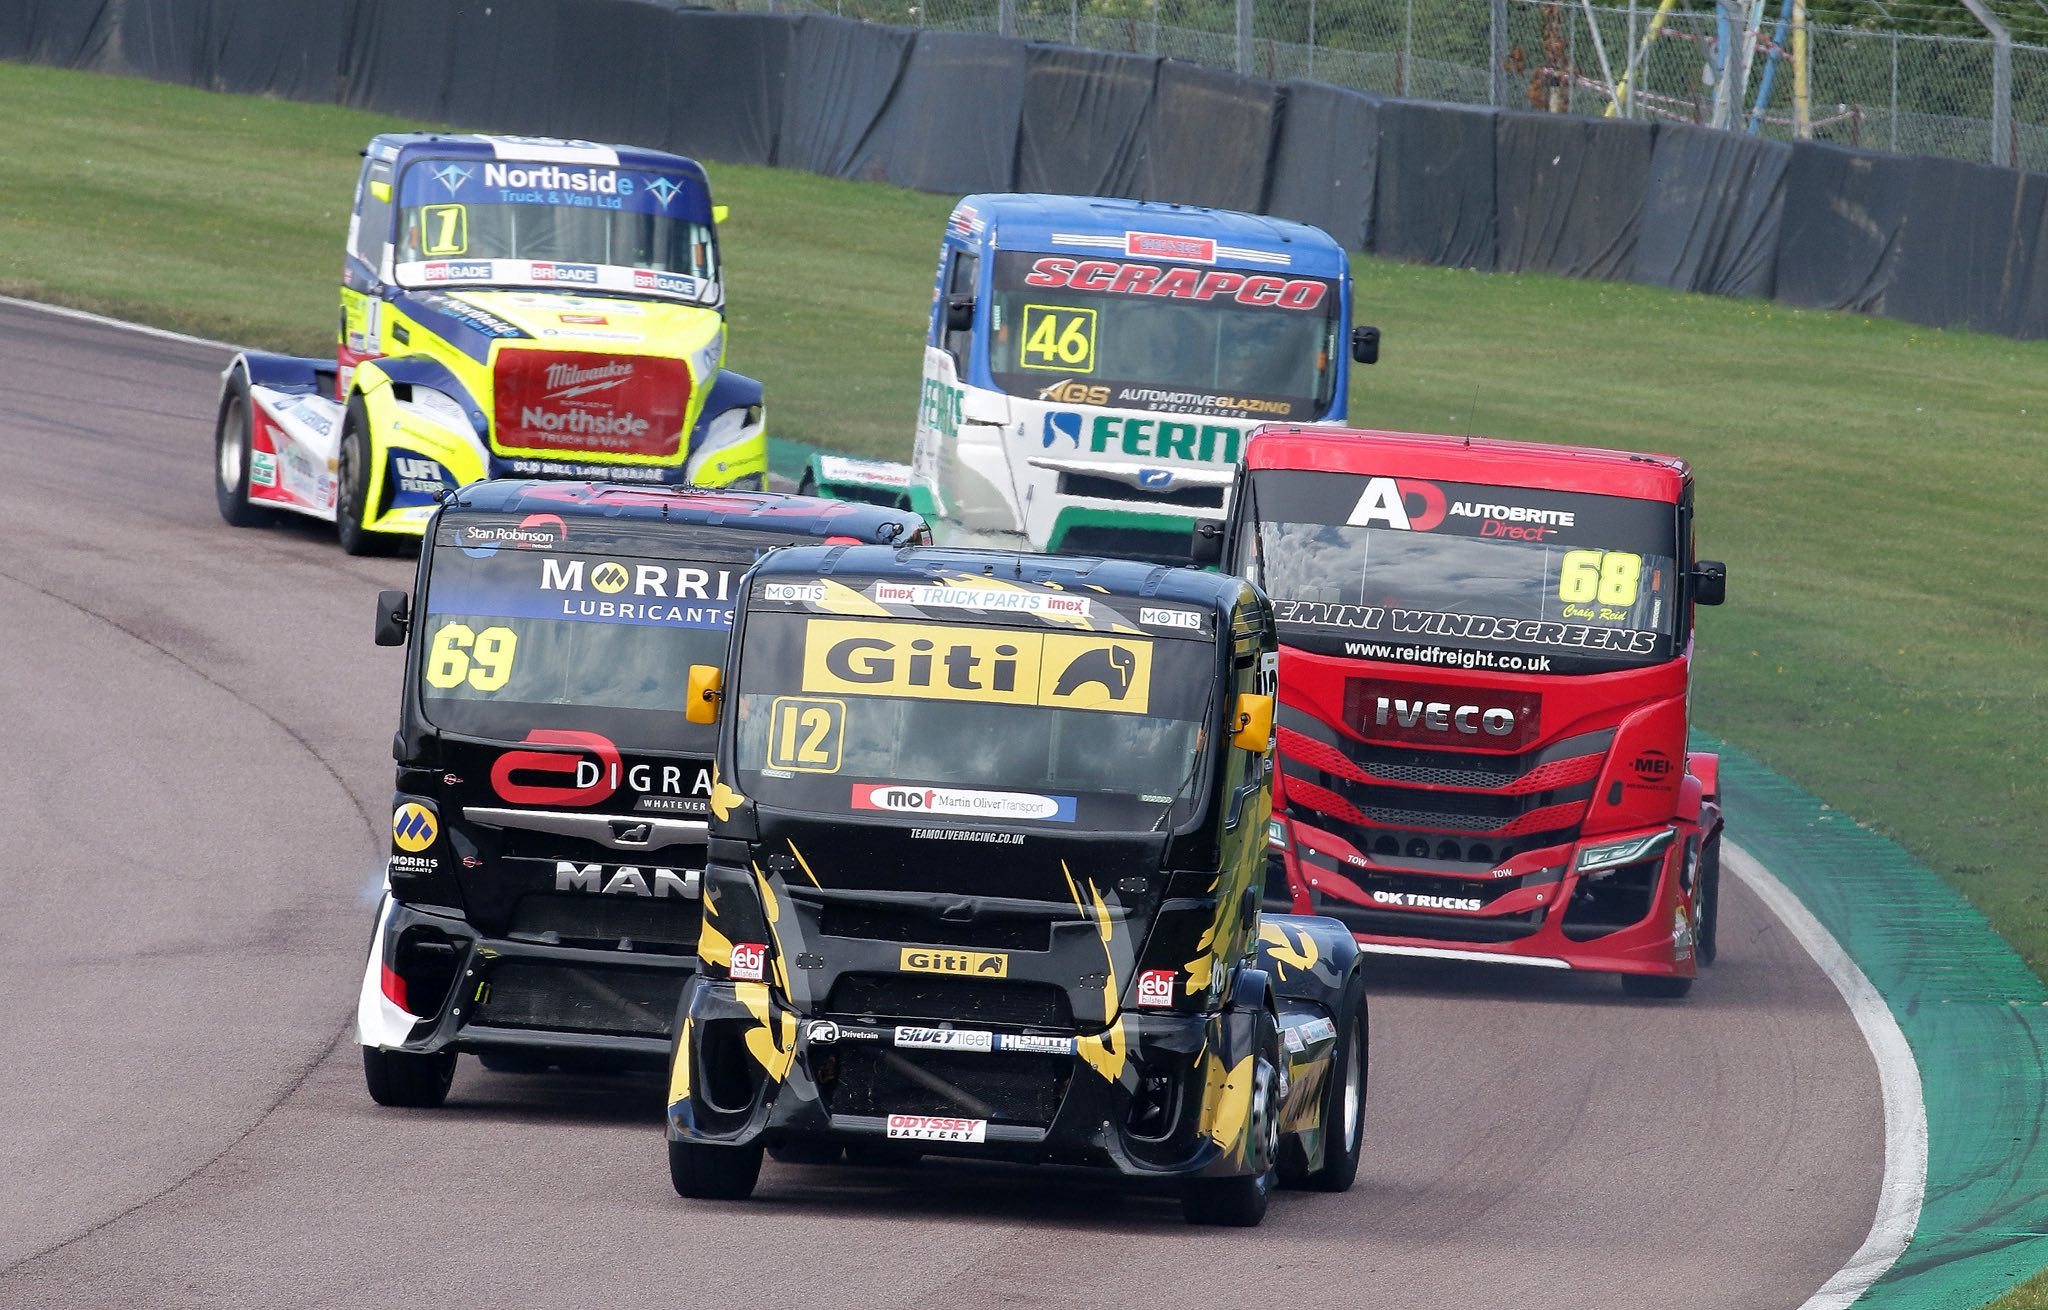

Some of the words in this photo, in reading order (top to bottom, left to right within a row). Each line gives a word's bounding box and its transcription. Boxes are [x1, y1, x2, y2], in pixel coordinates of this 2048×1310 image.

[485, 163, 634, 196] Northside
[500, 190, 546, 204] Truck
[550, 192, 560, 204] &
[563, 193, 592, 207] Van
[597, 195, 623, 208] Ltd
[434, 209, 459, 252] 1
[426, 264, 490, 279] BRIGADE
[532, 265, 596, 282] BRIGADE
[635, 273, 694, 293] BRIGADE
[1025, 258, 1327, 311] SCRAPCO
[1026, 314, 1090, 364] 46
[545, 360, 634, 390] Milwaukee
[521, 406, 650, 437] Northside
[1149, 403, 1248, 418] SPECIALISTS
[1090, 416, 1246, 464] FERN
[396, 457, 442, 480] UFI
[1450, 501, 1575, 527] AUTOBRITE
[467, 527, 494, 539] Stan
[496, 528, 554, 542] Robinson
[1480, 518, 1549, 542] Direct
[540, 559, 746, 601] MORRI
[1559, 550, 1642, 607] 68
[767, 586, 823, 600] MOTIS
[879, 586, 914, 600] imex
[922, 588, 980, 606] TRUCK
[983, 591, 1041, 610] PARTS
[1047, 597, 1083, 612] imex
[563, 599, 734, 626] LUBRICANTS
[1141, 611, 1198, 627] MOTIS
[1562, 604, 1595, 621] Craig
[1599, 608, 1627, 622] Reid
[1270, 599, 1385, 630] EMINI
[1393, 610, 1658, 653] WINDSCREENS
[426, 623, 518, 692] 69
[826, 637, 1018, 693] Giti
[1345, 642, 1551, 672] www.reidfreight.co.uk
[1375, 697, 1516, 736] IVECO
[782, 707, 830, 764] 12
[1634, 758, 1670, 773] MEI
[643, 799, 706, 811] WHATEVER
[938, 795, 971, 808] Martin
[910, 828, 1026, 845] TEAMOLIVERRACING.CO.UK
[392, 855, 438, 868] MORRIS
[1347, 855, 1367, 867] TOW
[554, 861, 700, 899] MAN
[1492, 868, 1513, 878] TOW
[1373, 891, 1404, 904] OK
[1406, 893, 1481, 911] TRUCKS
[730, 944, 765, 970] febi
[907, 953, 967, 972] Giti
[1138, 971, 1174, 996] febi
[841, 1030, 879, 1040] Drivetrain
[897, 1028, 957, 1045] SILVEY
[957, 1031, 991, 1047] fleet
[890, 1115, 980, 1132] ODYSSEY
[890, 1129, 972, 1140] BATTERY
